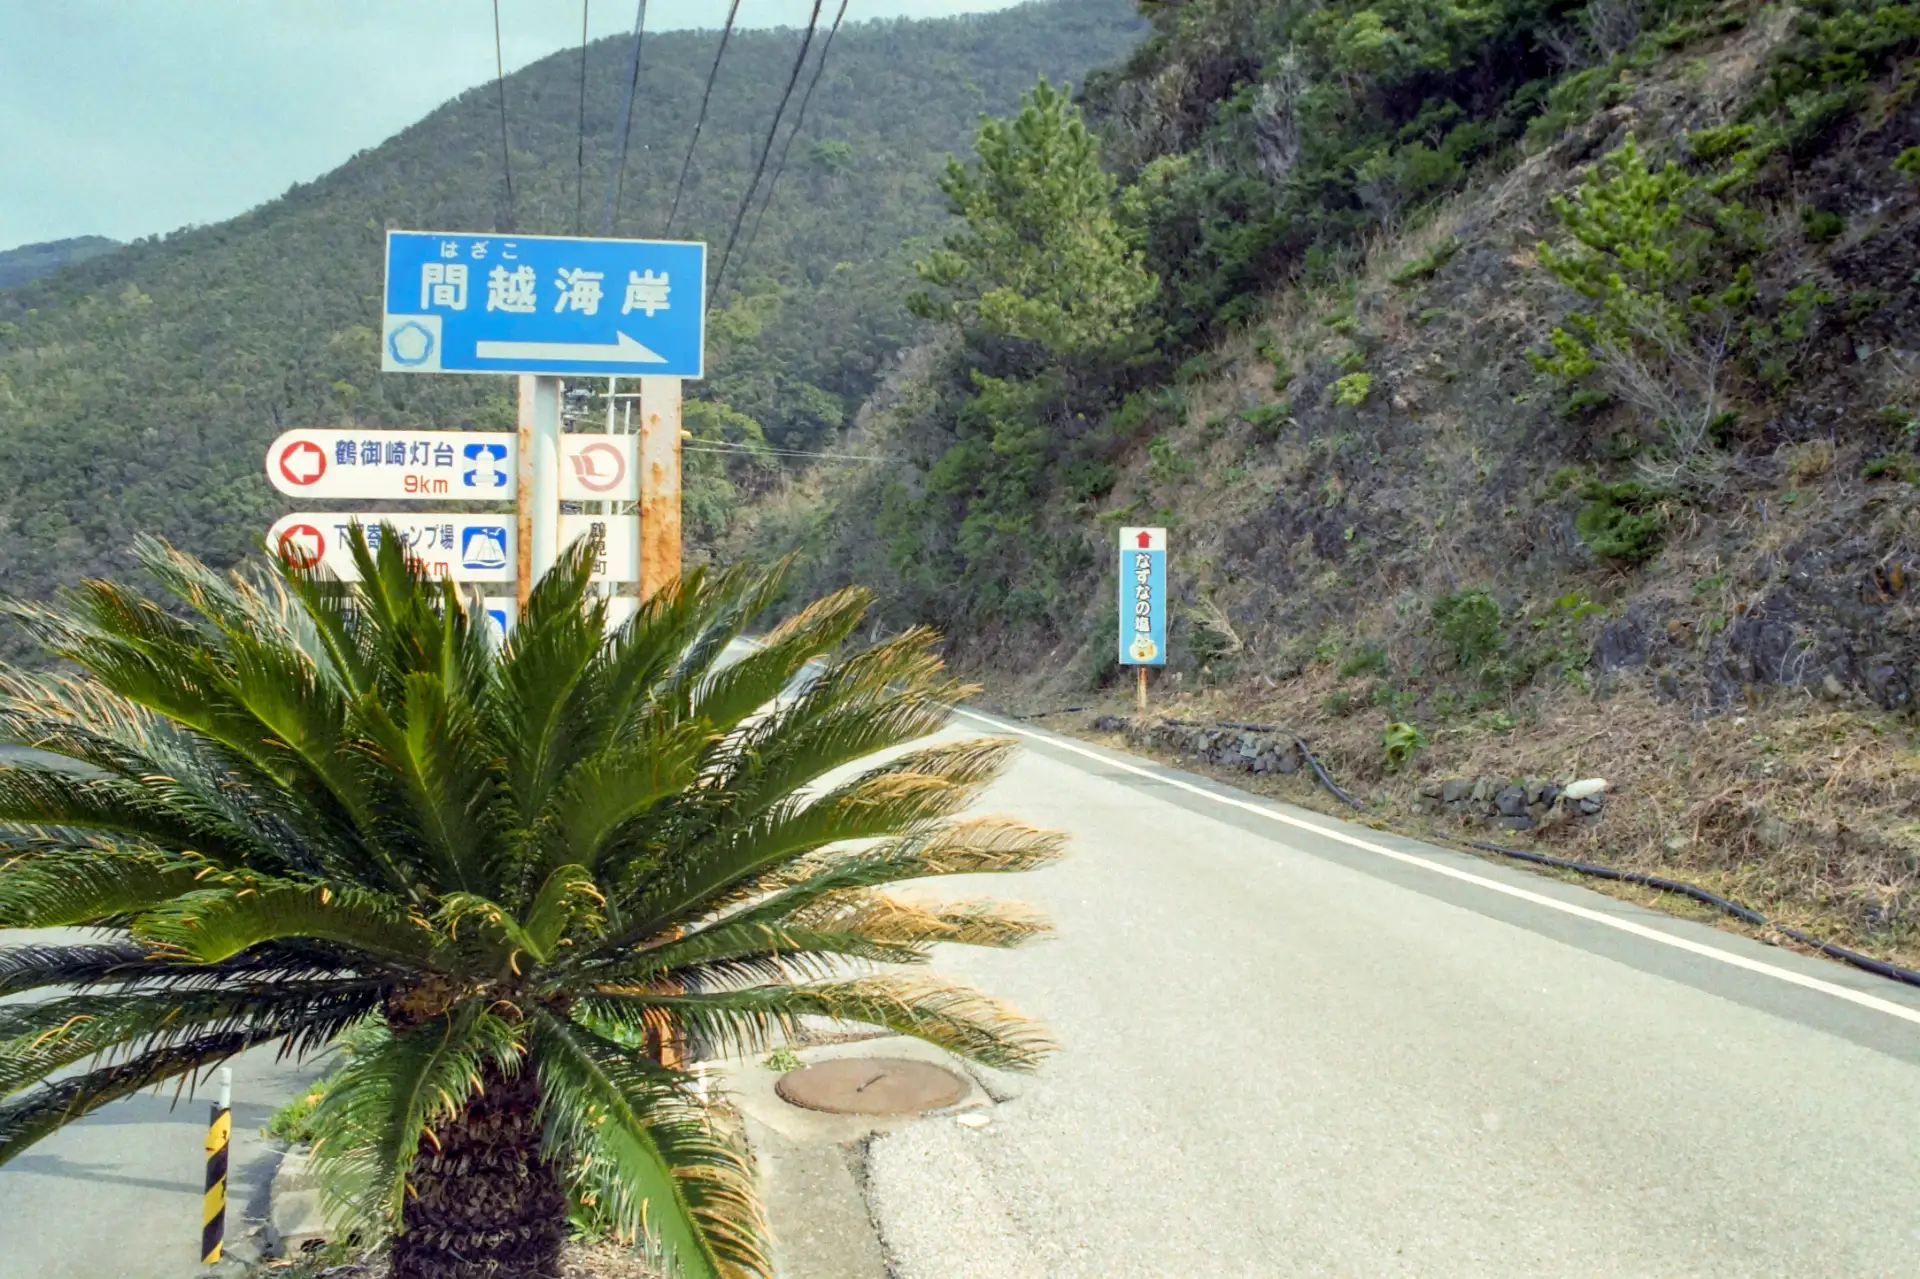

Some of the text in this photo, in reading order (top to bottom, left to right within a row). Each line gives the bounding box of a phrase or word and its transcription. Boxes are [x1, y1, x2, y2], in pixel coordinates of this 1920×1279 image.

[440, 240, 518, 260] はざこ
[421, 262, 672, 317] 間越海岸
[335, 439, 455, 468] 鶴御崎灯台
[404, 474, 449, 494] 9km
